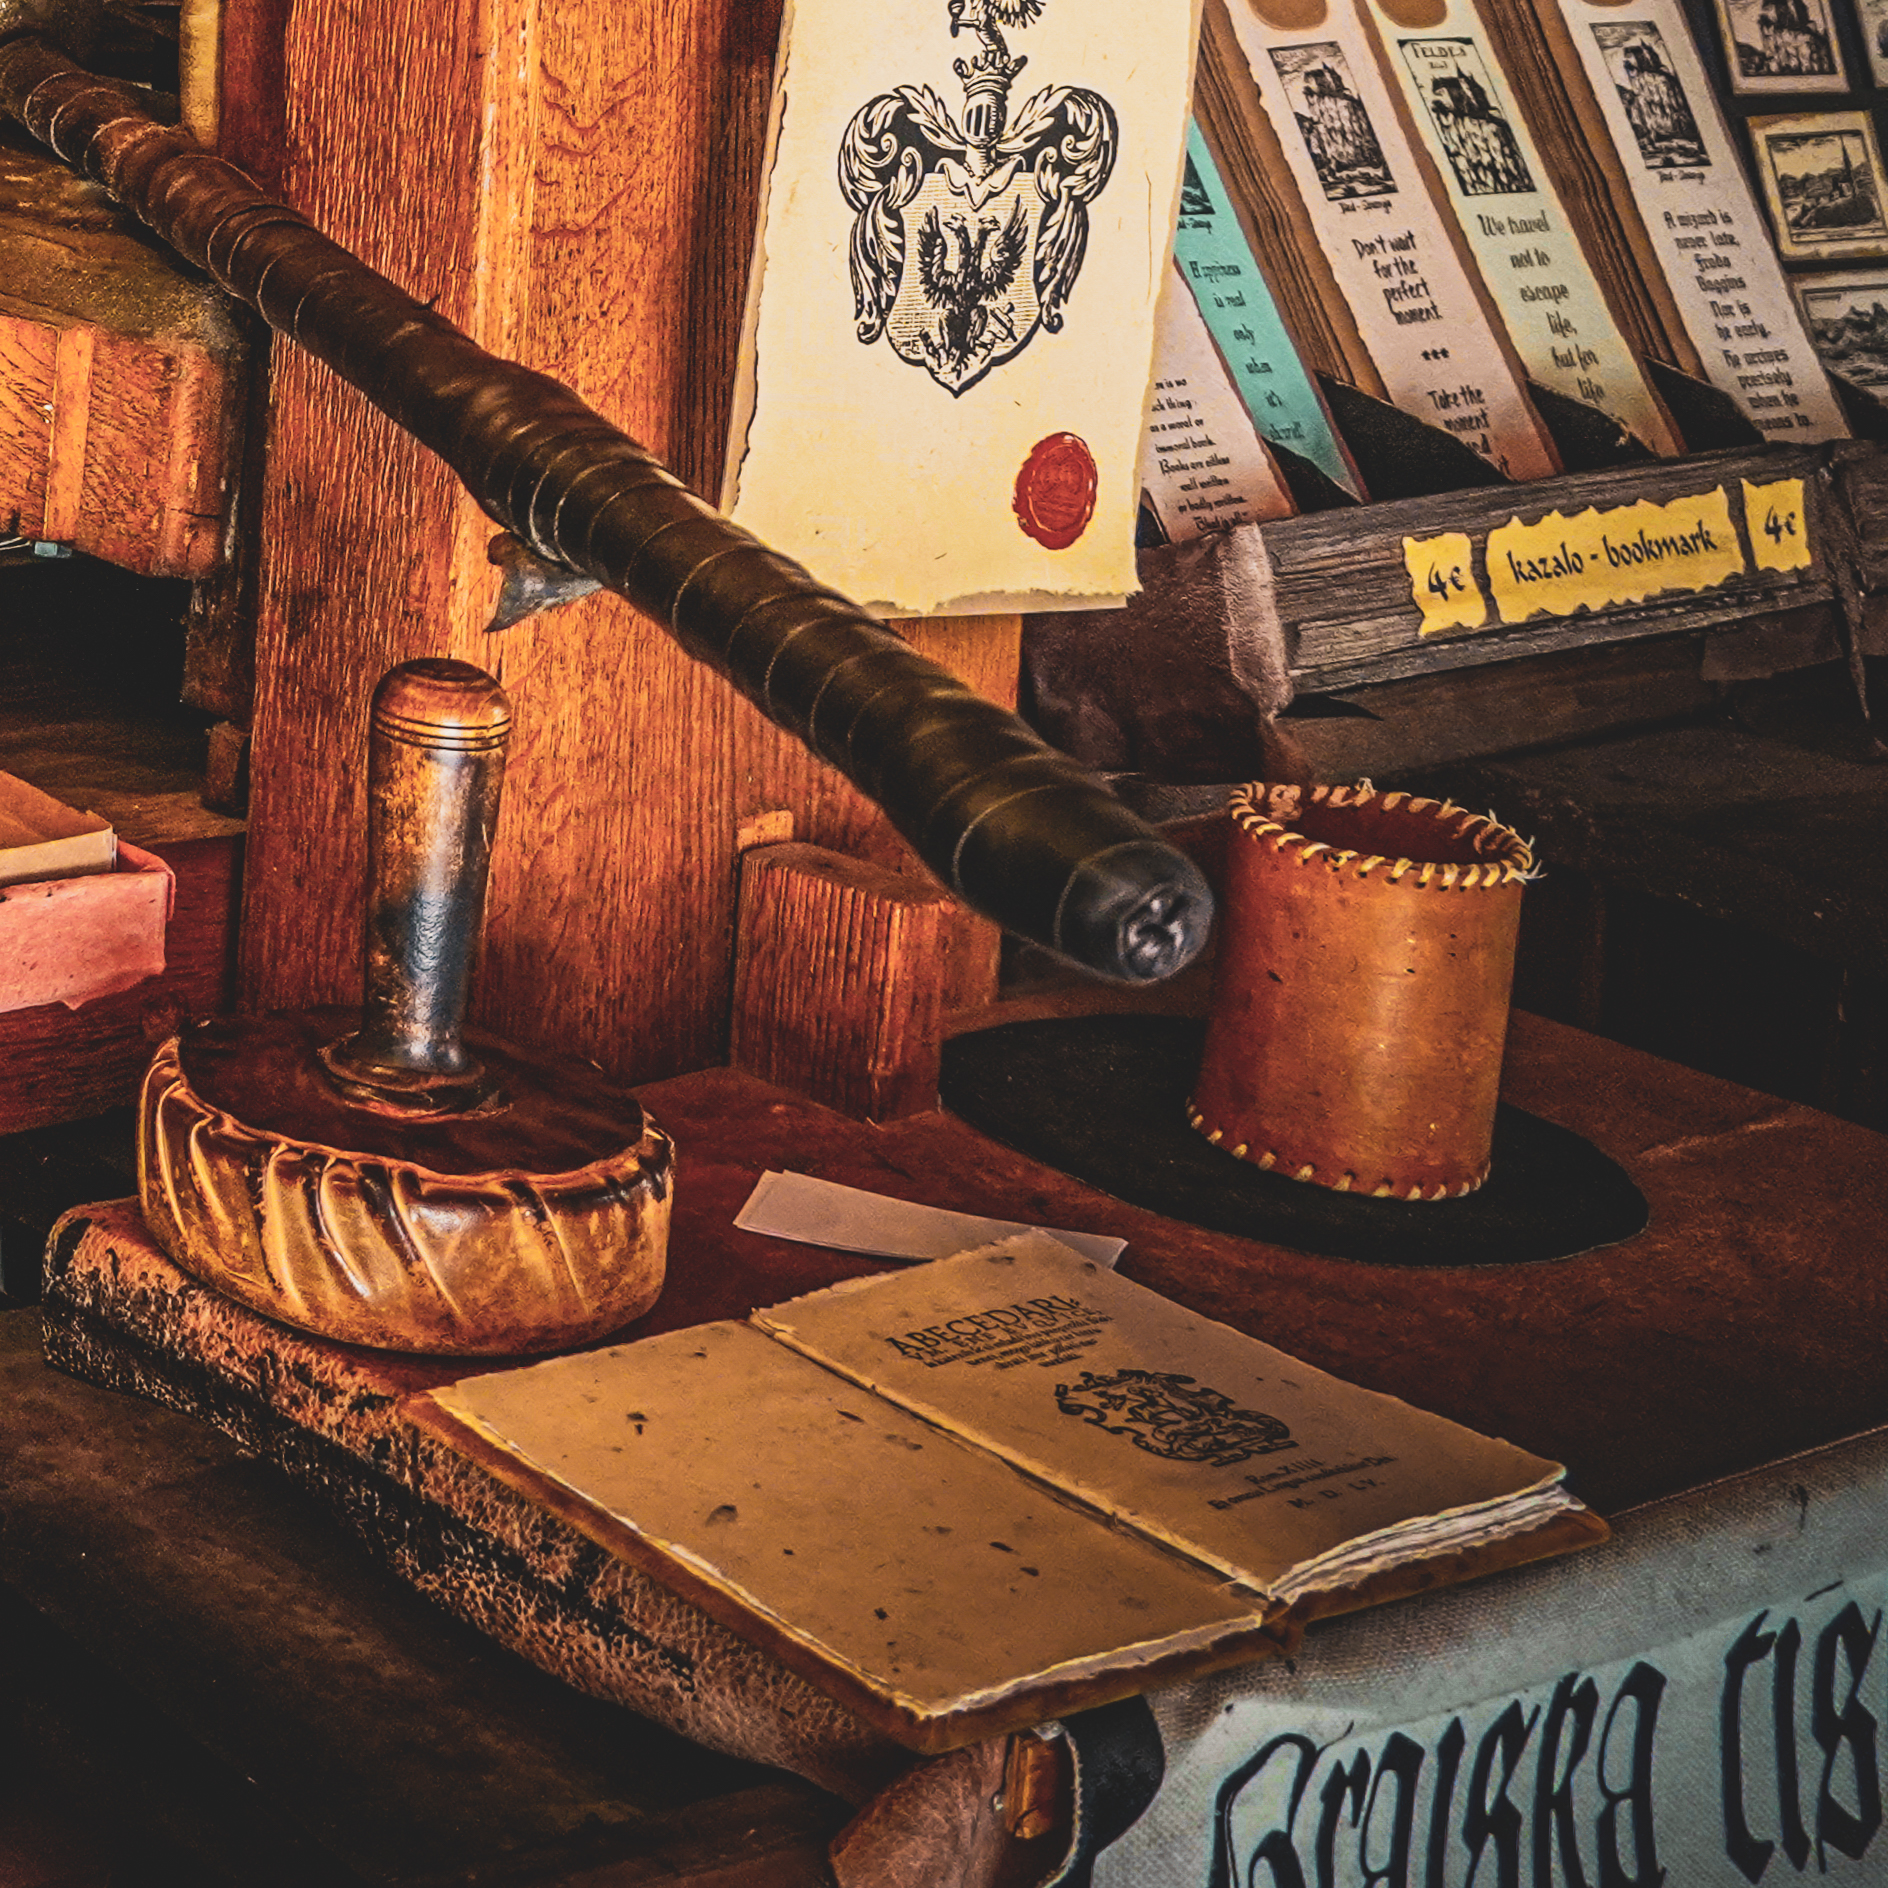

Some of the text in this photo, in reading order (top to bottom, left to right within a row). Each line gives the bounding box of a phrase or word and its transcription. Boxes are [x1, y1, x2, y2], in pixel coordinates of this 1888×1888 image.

[1477, 210, 1551, 236] We travel
[1663, 209, 1734, 229] A wizard is
[1352, 230, 1417, 260] Don't wait
[1674, 231, 1740, 252] never late,
[1372, 256, 1418, 279] for the
[1510, 248, 1551, 269] not to
[1383, 277, 1432, 312] perfect
[1520, 282, 1570, 305] escape
[1695, 274, 1747, 294] Baggins
[1394, 304, 1443, 325] moment
[1709, 299, 1752, 318] Nor is
[1233, 323, 1255, 346] only
[1545, 311, 1578, 338] life,
[1714, 322, 1732, 341] he
[1550, 345, 1576, 369] but
[1743, 348, 1790, 365] arrives
[1736, 370, 1793, 390] precisely
[1428, 384, 1486, 411] Take the
[1747, 389, 1800, 409] when he
[1506, 542, 1584, 584] kazalo
[1602, 519, 1719, 569] bookmark
